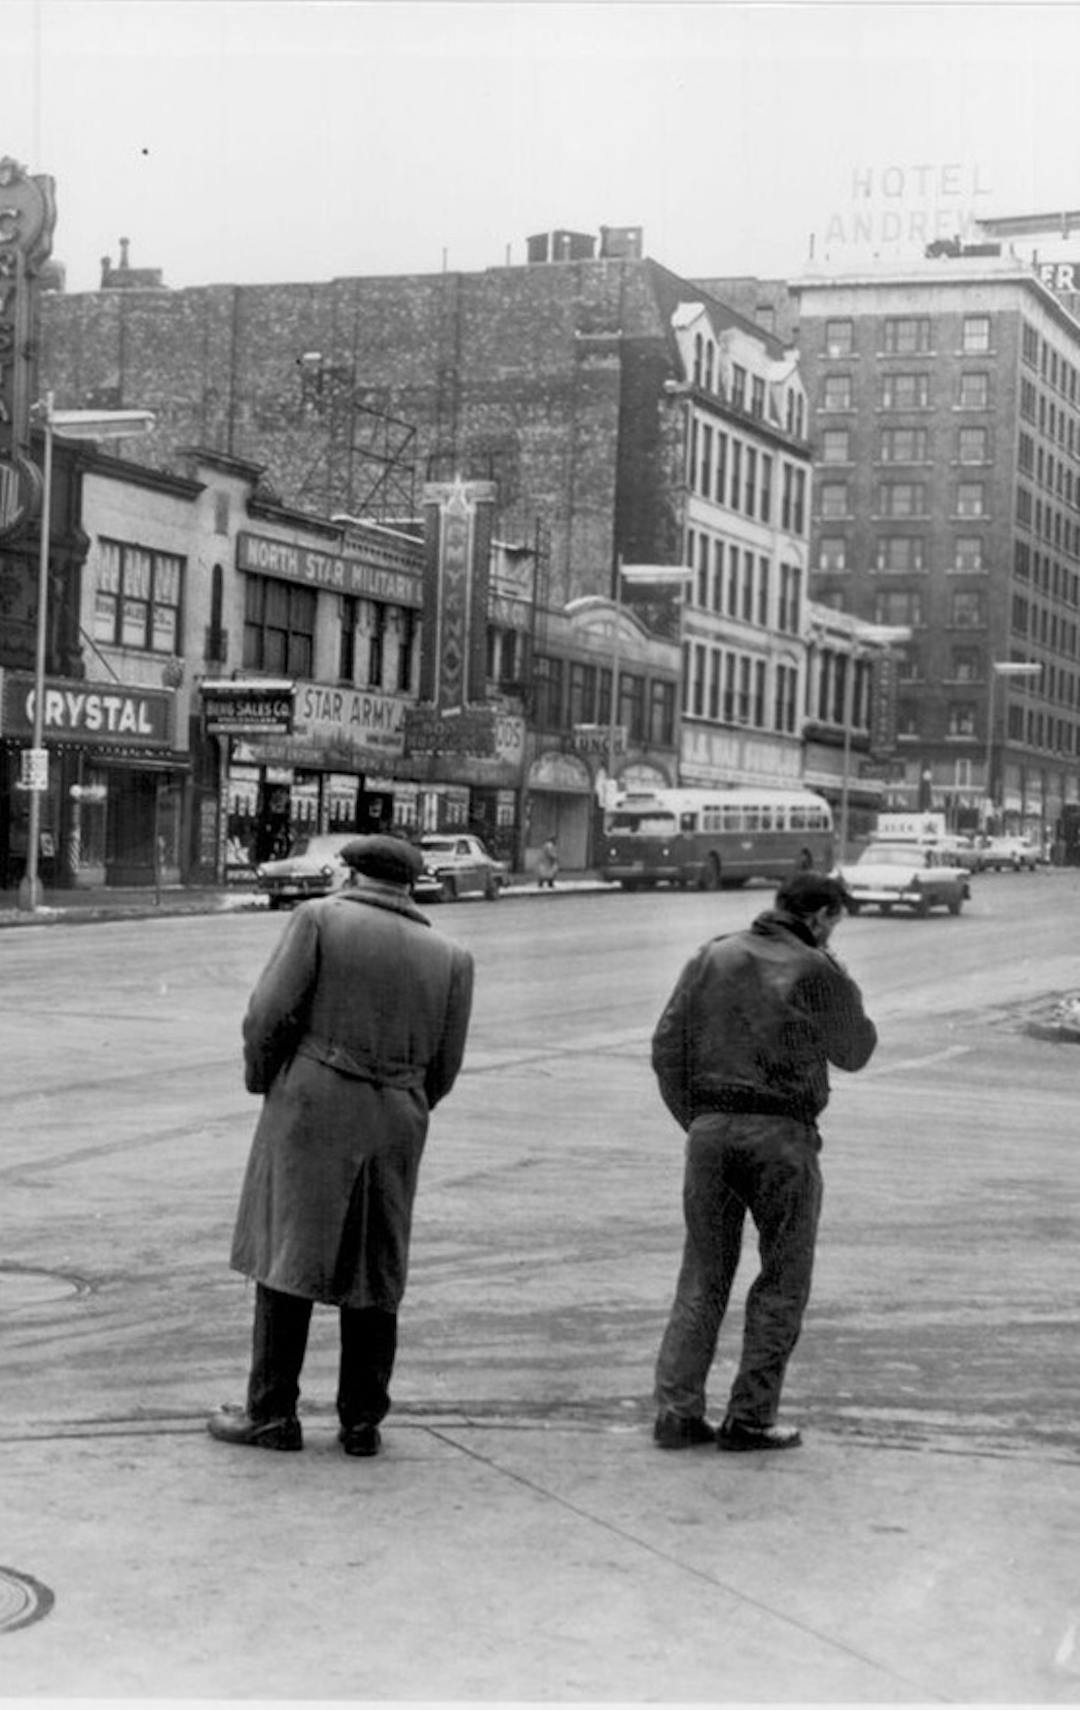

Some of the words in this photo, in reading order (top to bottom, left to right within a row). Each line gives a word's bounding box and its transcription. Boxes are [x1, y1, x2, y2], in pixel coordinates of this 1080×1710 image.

[852, 164, 993, 198] HOTEL
[247, 538, 299, 576] NORTH
[305, 553, 345, 586] STAR
[351, 564, 416, 602] MILITARY
[25, 689, 153, 734] CRYSTAL
[236, 700, 271, 717] SALES
[304, 688, 343, 722] STAR
[351, 697, 395, 731] ARMY
